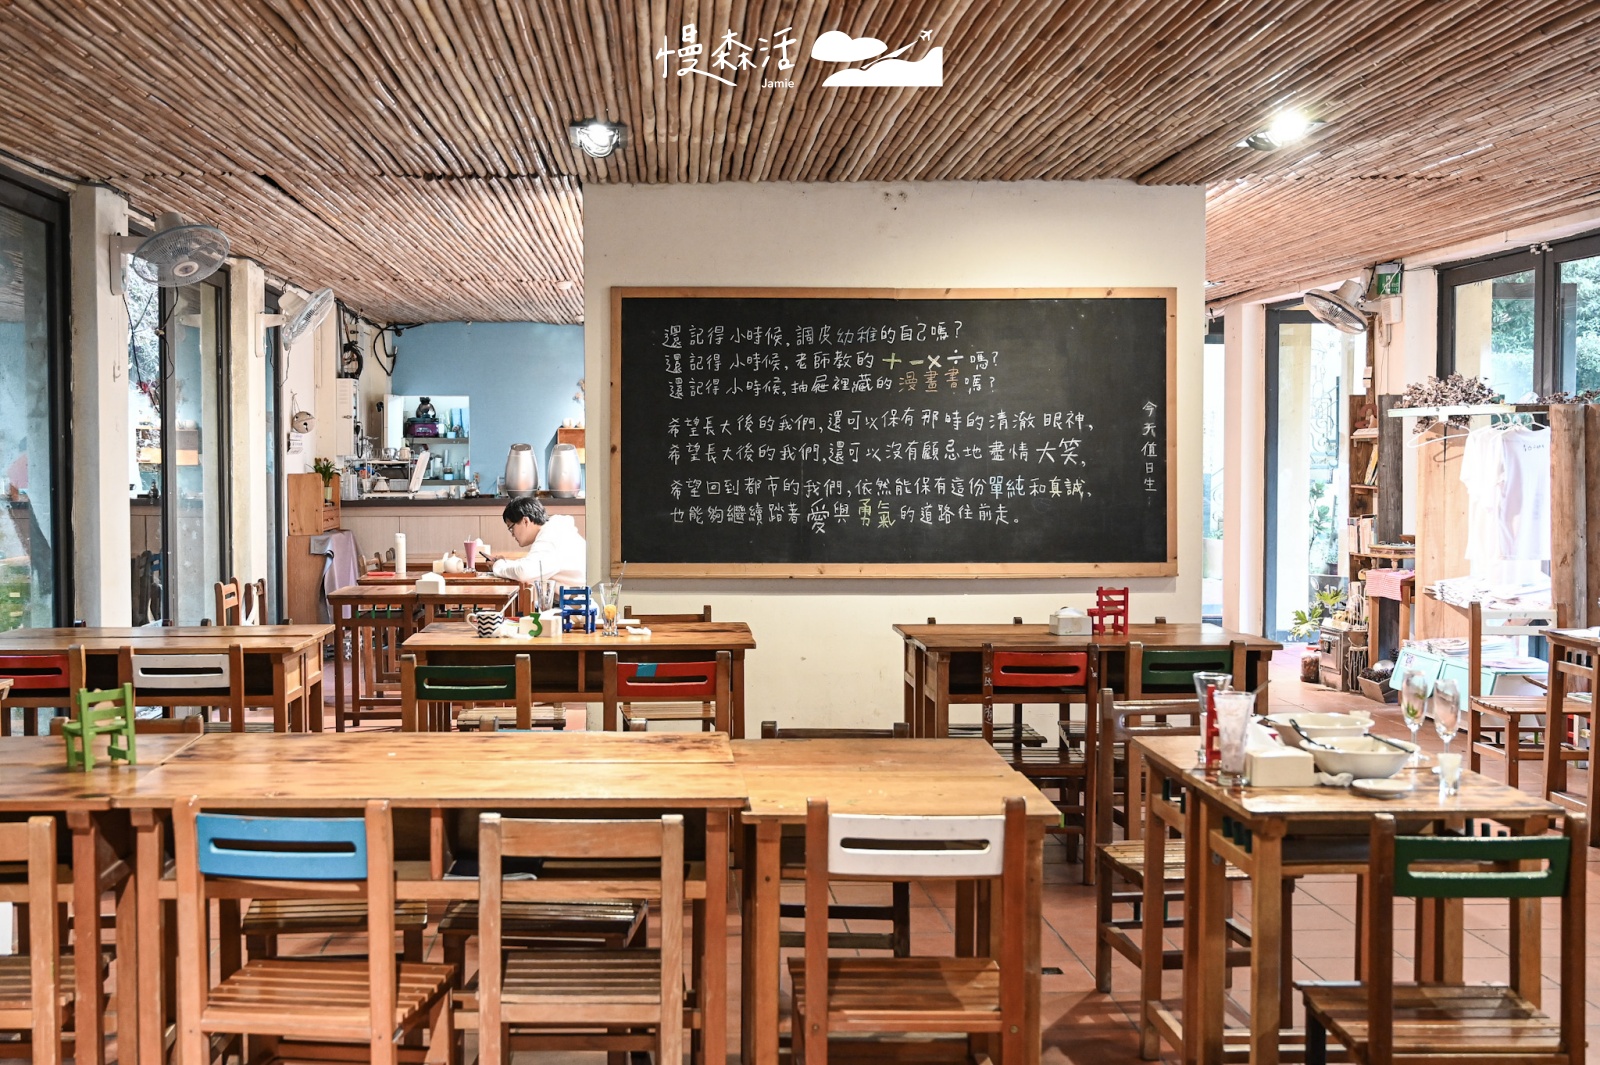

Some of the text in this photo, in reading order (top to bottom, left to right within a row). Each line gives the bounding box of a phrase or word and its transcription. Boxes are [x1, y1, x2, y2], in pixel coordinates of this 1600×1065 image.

[1140, 400, 1158, 492] 今天值日生
[529, 612, 542, 637] 3
